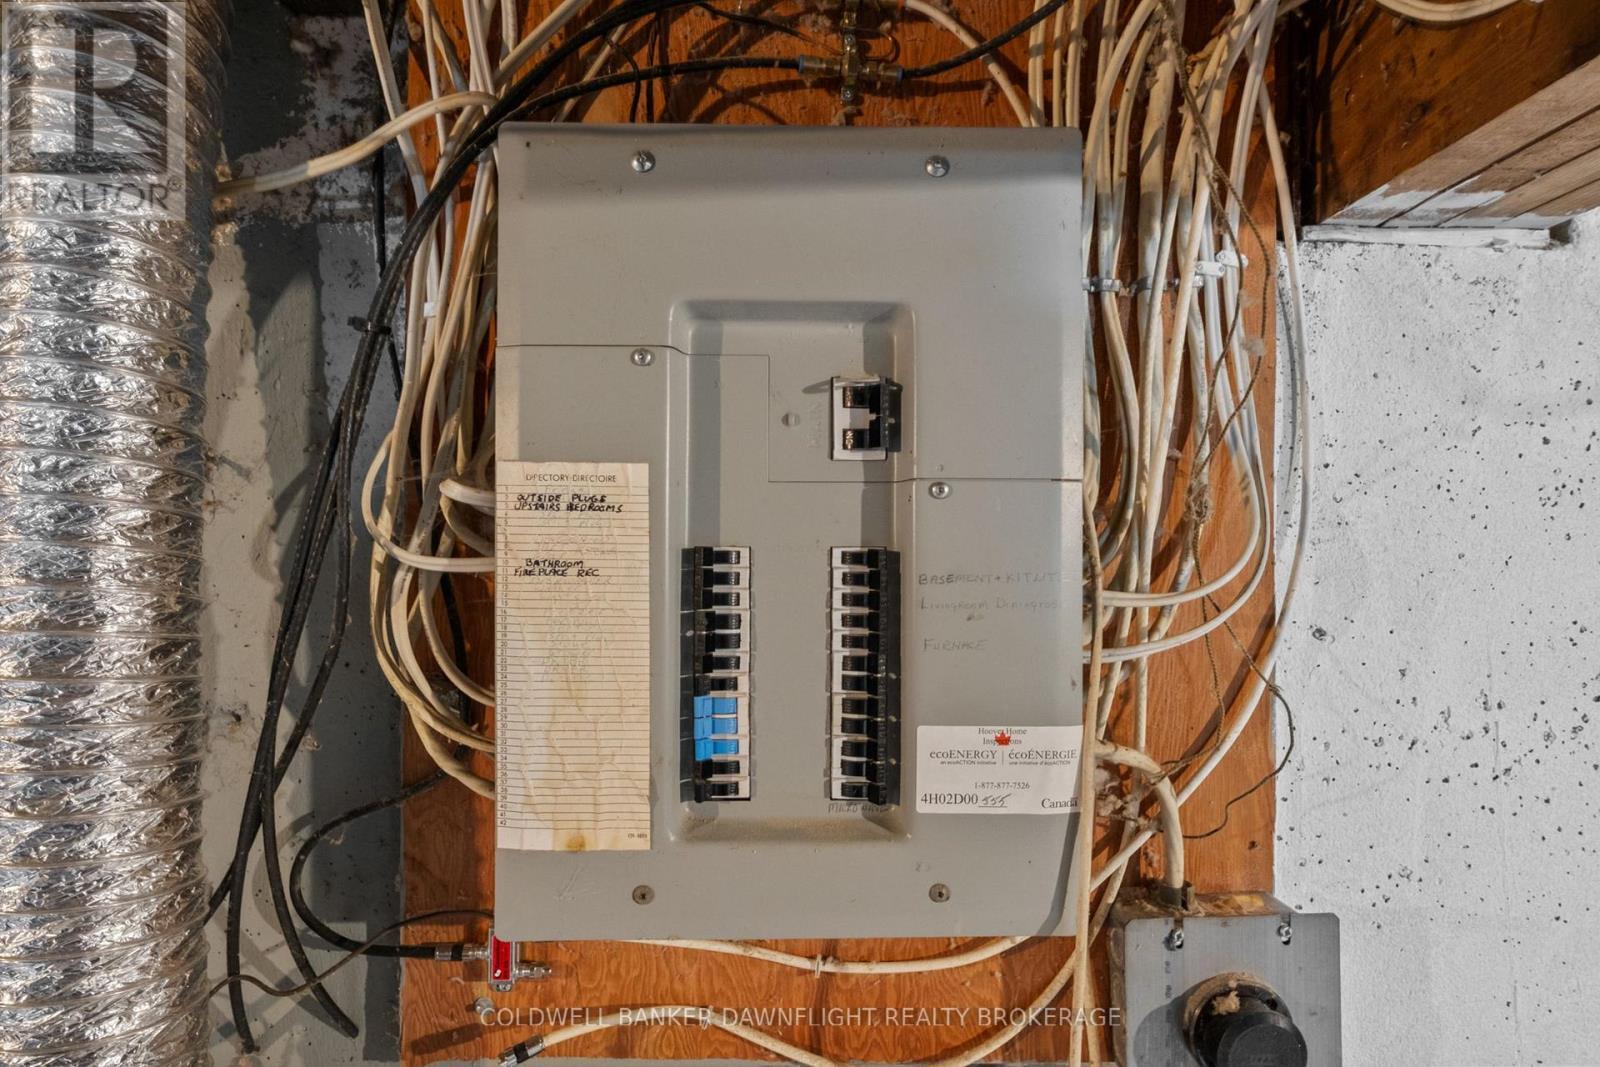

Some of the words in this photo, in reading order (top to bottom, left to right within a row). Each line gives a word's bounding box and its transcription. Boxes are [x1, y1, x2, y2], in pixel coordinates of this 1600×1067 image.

[516, 493, 562, 502] OUTSIDE
[571, 493, 607, 503] PLUGS
[514, 502, 561, 512] UPSTAIRS
[566, 503, 623, 513] BEDROOMS
[525, 558, 584, 569] BATHROOM
[514, 568, 568, 577] FIREPLACE
[577, 568, 600, 577] REC
[1006, 727, 1027, 735] Home
[982, 737, 1022, 746] Inspons
[929, 750, 997, 759] ecoENERGY
[1008, 749, 1077, 759] écoÉNERGIE
[974, 781, 1030, 790] 1-877-877-7526
[920, 793, 979, 805] 4H02D00
